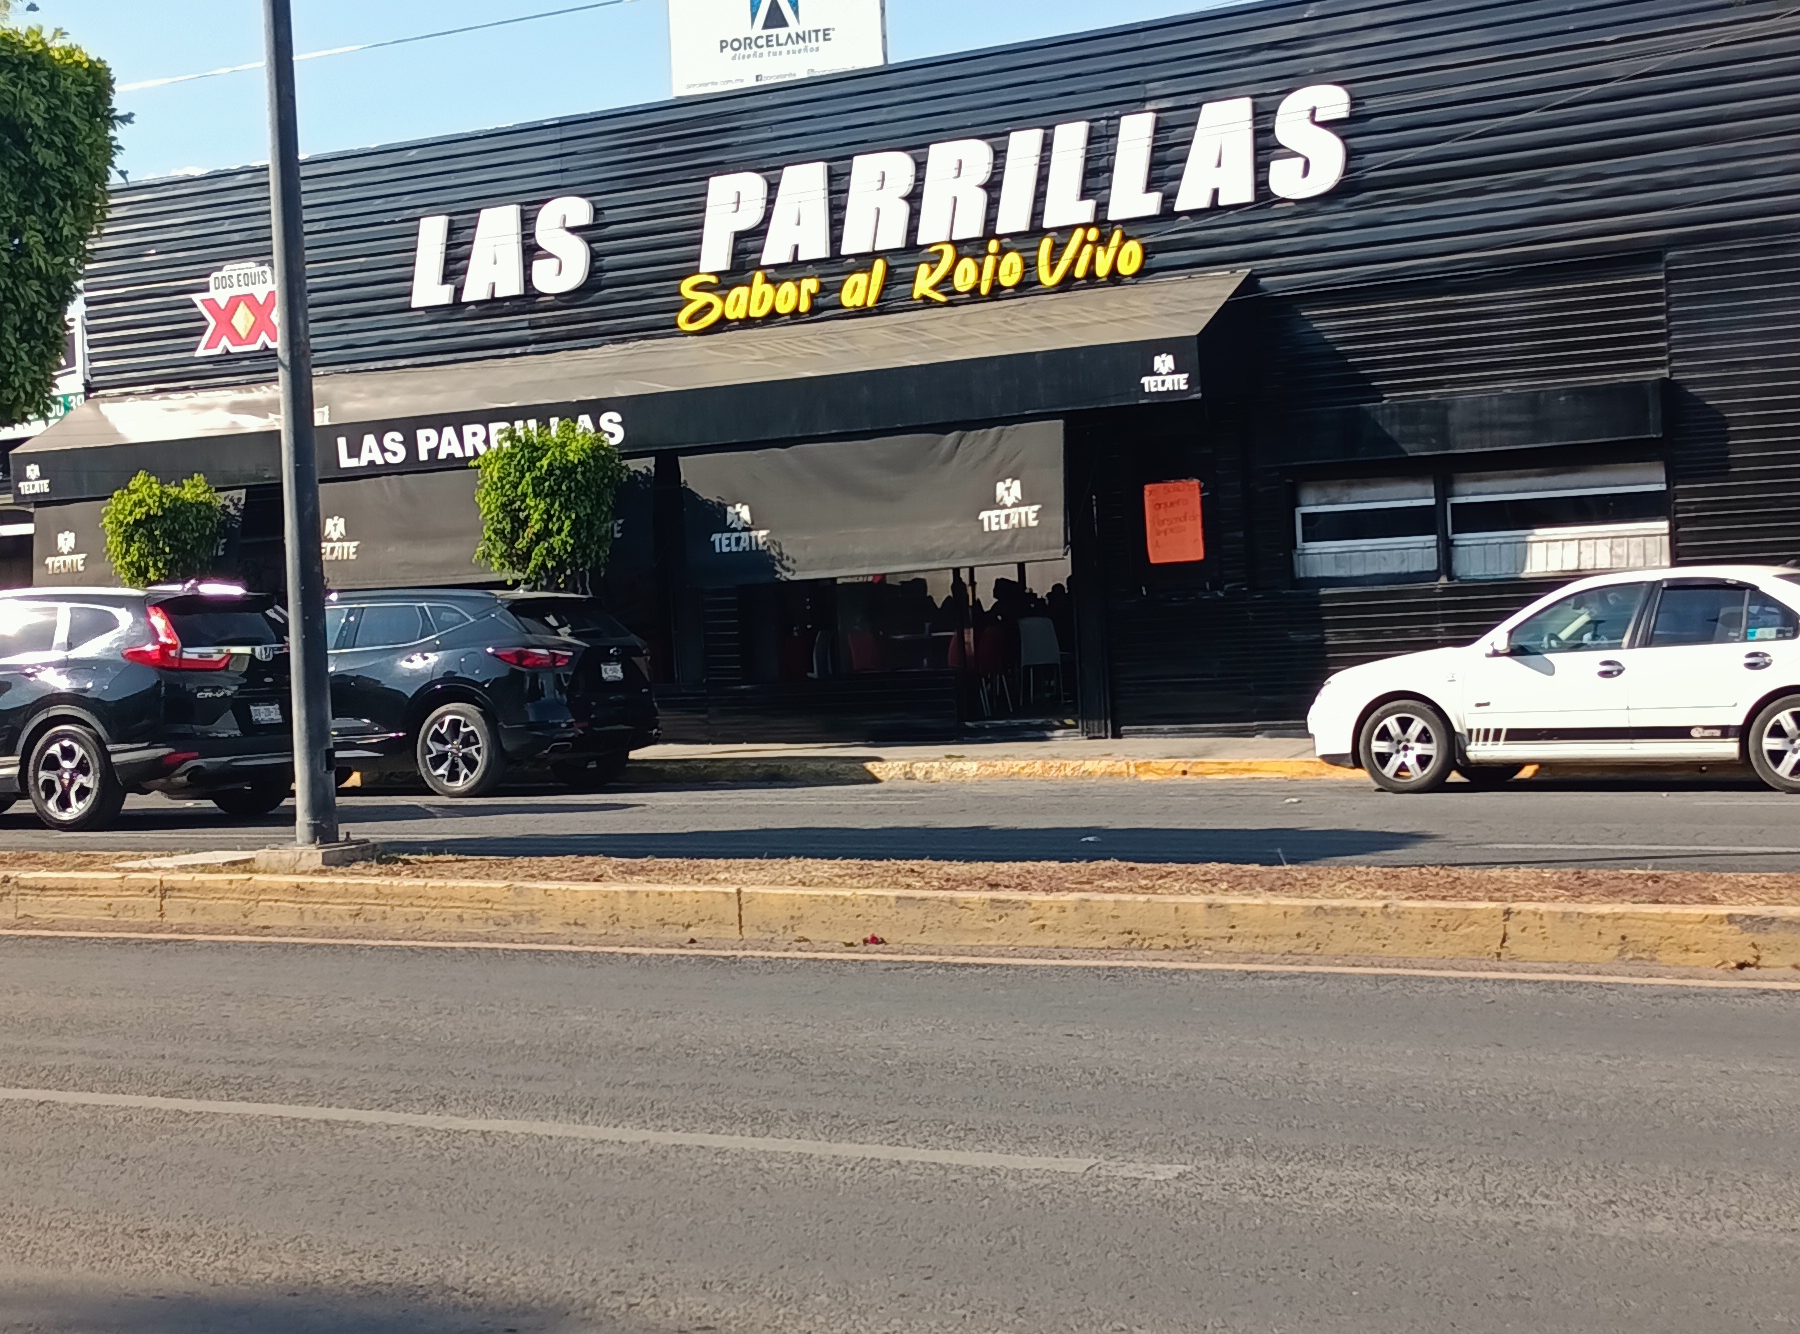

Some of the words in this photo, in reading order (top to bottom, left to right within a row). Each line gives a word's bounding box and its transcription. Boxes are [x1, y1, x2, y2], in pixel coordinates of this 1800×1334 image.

[719, 27, 832, 53] PORCELANITE
[767, 50, 782, 58] tus
[411, 196, 594, 308] LAS
[699, 84, 1351, 272] PARRILLAS
[214, 275, 234, 290] DOS
[237, 270, 267, 287] EQUIS
[676, 271, 820, 332] Sabor
[840, 258, 887, 308] al
[913, 239, 1024, 302] Rojo
[1037, 226, 1144, 287] Vivo
[200, 290, 277, 350] XX
[1140, 373, 1189, 392] TECATE
[337, 431, 406, 468] LAS
[18, 479, 50, 495] TECATE
[978, 505, 1042, 532] TECATE
[320, 541, 361, 561] ECATE
[711, 530, 770, 553] TECATE
[45, 554, 88, 575] TECATE
